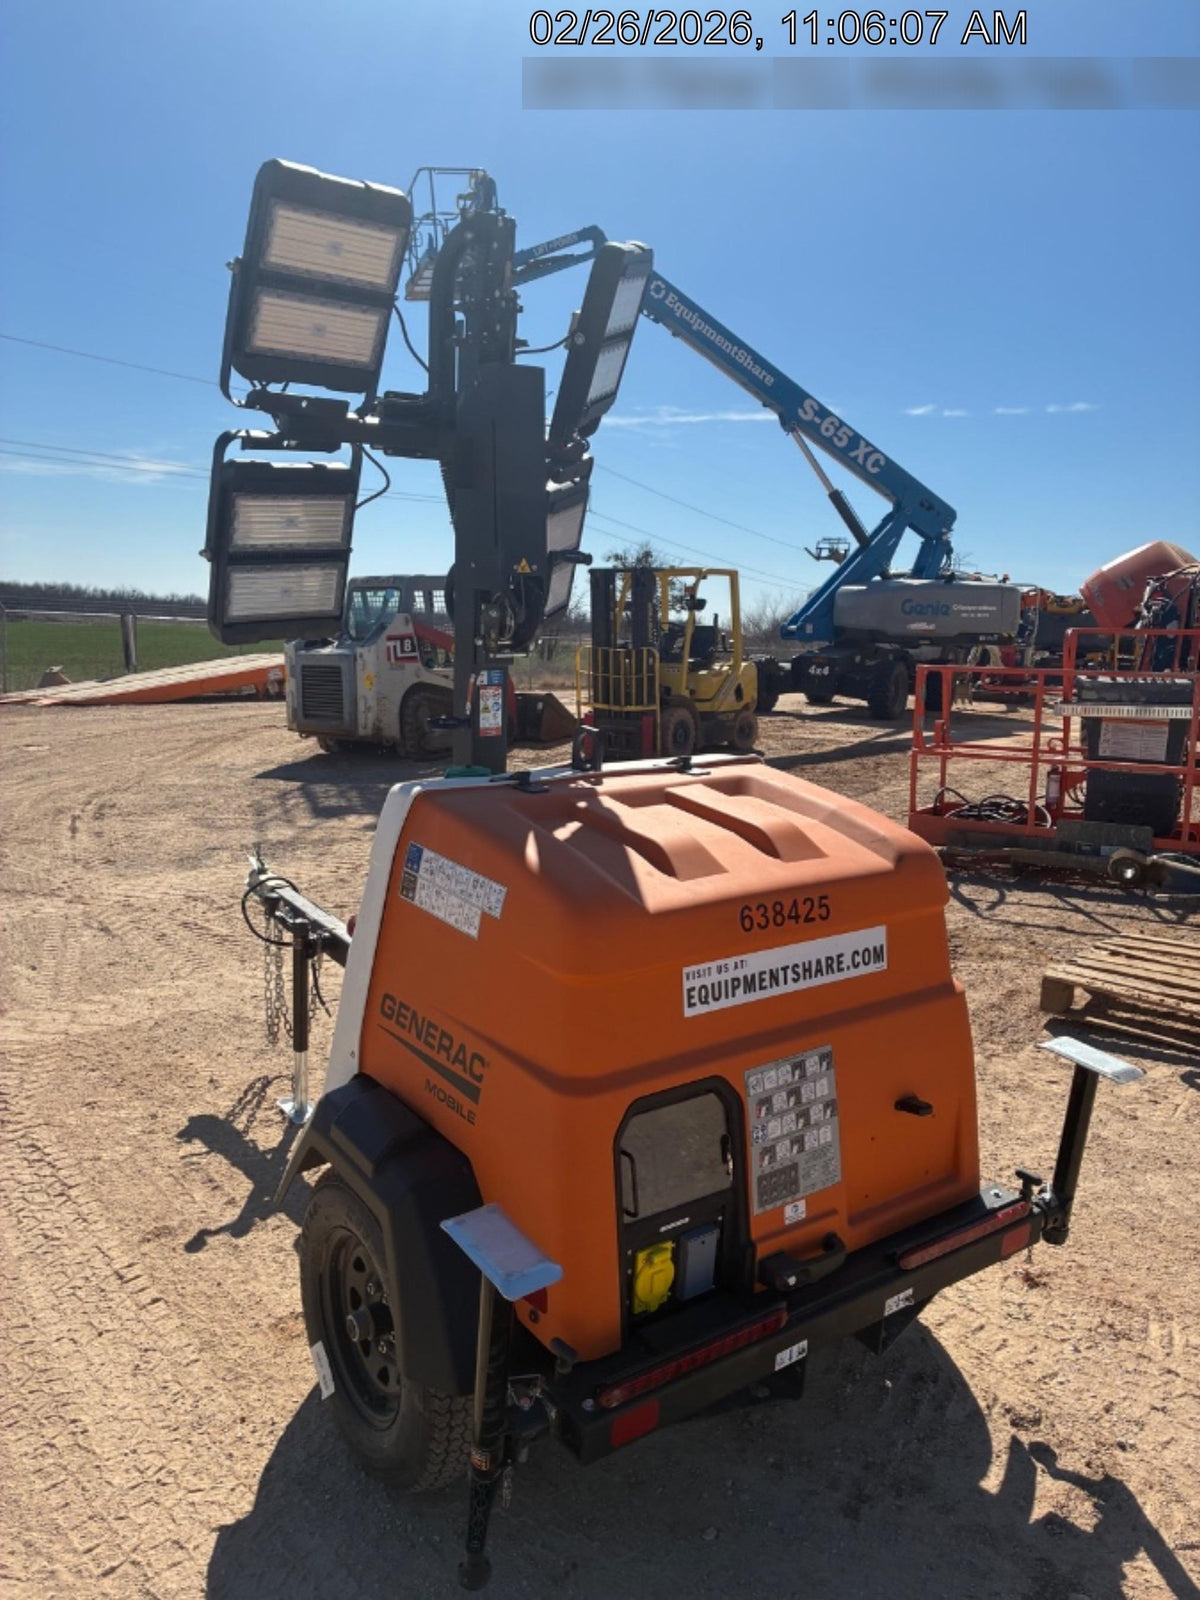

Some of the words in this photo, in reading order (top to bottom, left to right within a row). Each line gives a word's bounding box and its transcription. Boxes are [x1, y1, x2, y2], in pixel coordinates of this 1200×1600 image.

[664, 291, 776, 388] EquipmentShare
[797, 397, 855, 448] S-65
[848, 440, 887, 475] XC
[900, 598, 951, 617] Genie
[808, 664, 831, 677] 4x4
[740, 895, 831, 932] 638425
[685, 966, 712, 982] VISIT
[716, 963, 730, 975] US
[733, 959, 748, 972] AT:
[686, 943, 885, 1008] EQUIPMENTSHARE.COM
[379, 992, 486, 1084] GENERAC
[424, 1078, 477, 1127] MOBILE
